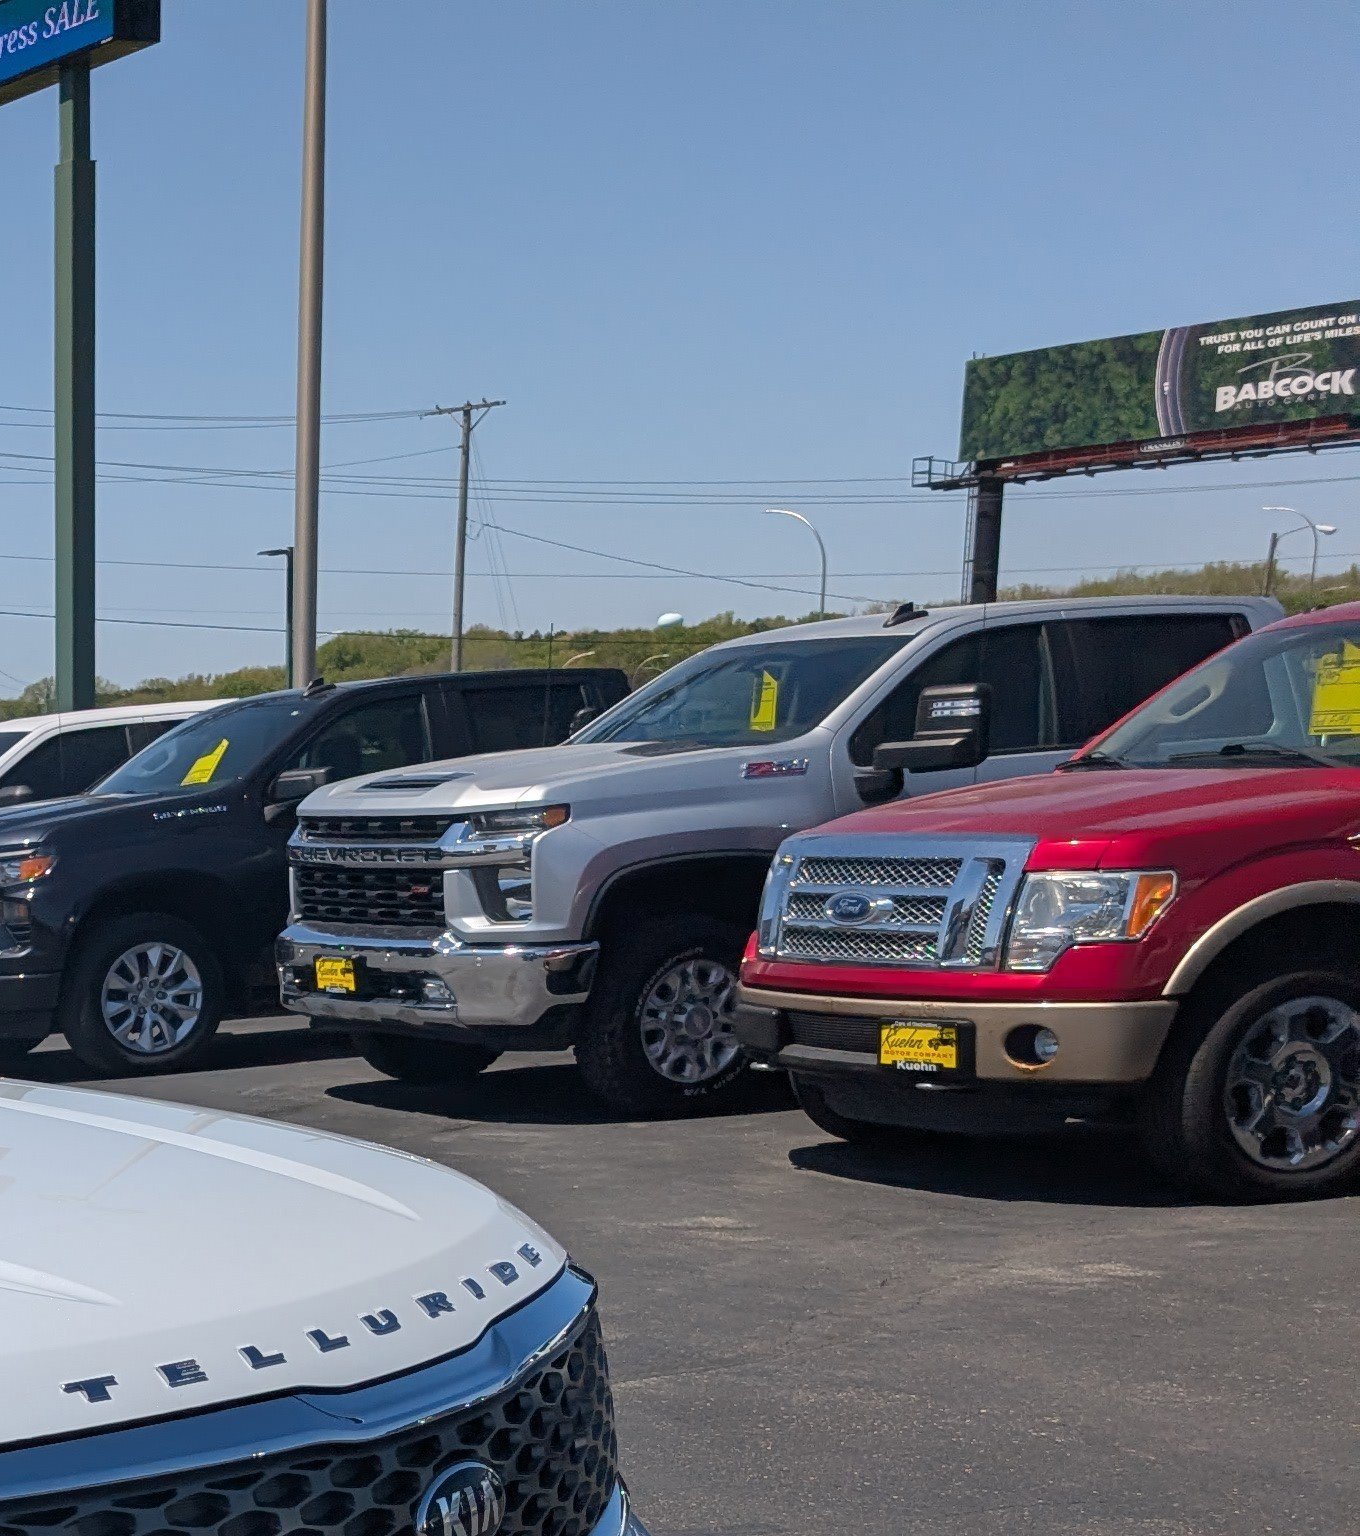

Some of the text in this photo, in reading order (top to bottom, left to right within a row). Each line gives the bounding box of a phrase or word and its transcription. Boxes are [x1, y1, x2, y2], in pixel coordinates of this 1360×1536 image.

[43, 0, 100, 38] SALE
[1199, 314, 1357, 346] TRUST YOU CAN COUNT ON
[1217, 343, 1241, 354] FOR
[1243, 340, 1265, 351] ALL
[1267, 337, 1284, 347] OF
[1285, 331, 1322, 345] LIFE'S
[1215, 368, 1357, 412] BABCOCK
[1233, 392, 1327, 411] AUTO CARE
[881, 1025, 924, 1050] Kuehn
[883, 1049, 954, 1059] MOTOR COMPANY
[896, 1060, 937, 1071] Kuehn
[60, 1241, 542, 1404] TELLURIDE
